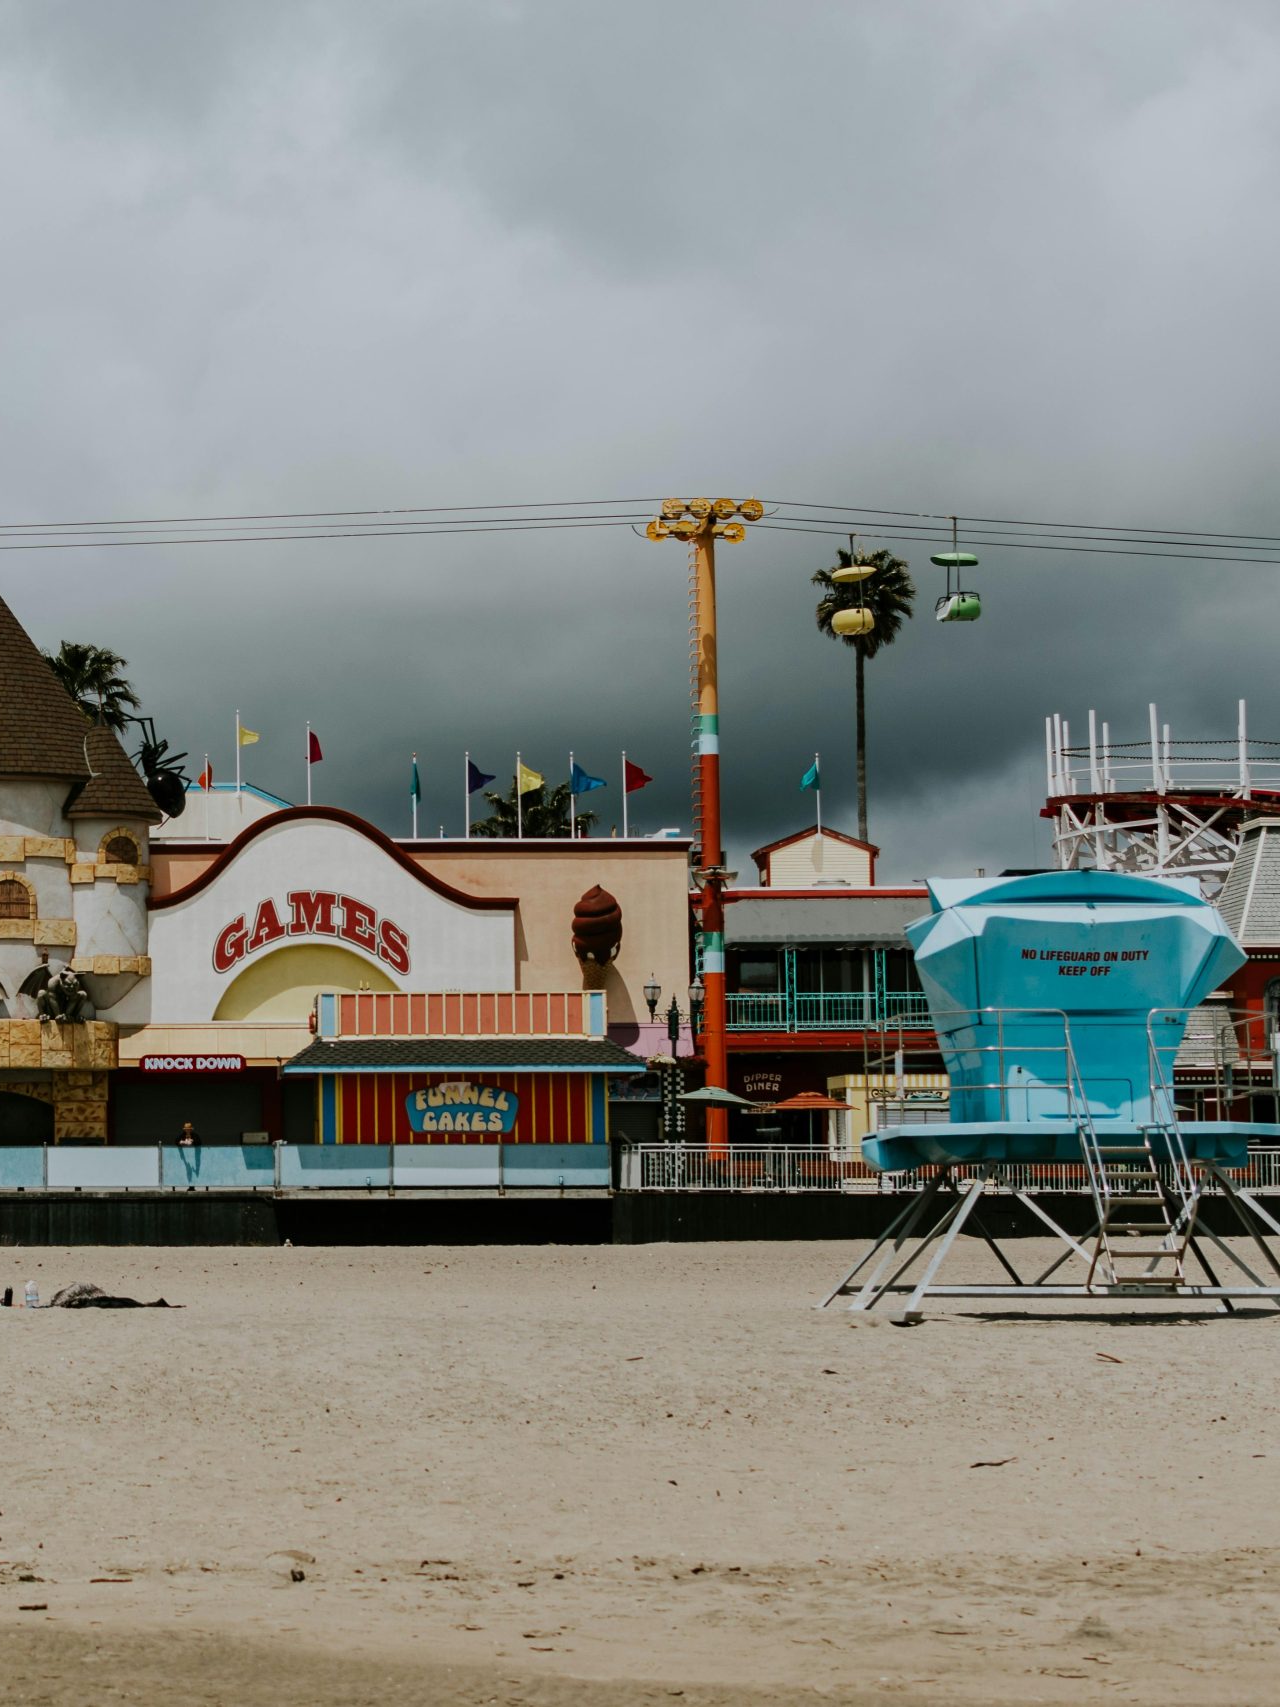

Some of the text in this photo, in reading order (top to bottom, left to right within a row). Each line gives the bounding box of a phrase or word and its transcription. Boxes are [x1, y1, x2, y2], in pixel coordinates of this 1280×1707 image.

[213, 890, 411, 975] GAMES
[1021, 949, 1149, 962] NO LIFEGUARD ON DUTY
[1058, 966, 1111, 976] KEEP OFF
[144, 1058, 241, 1070] KNOCK DOWN
[743, 1073, 782, 1083] DIPPER
[746, 1082, 780, 1092] DINER
[415, 1085, 509, 1111] FUNNEL
[423, 1112, 503, 1131] CAKES
